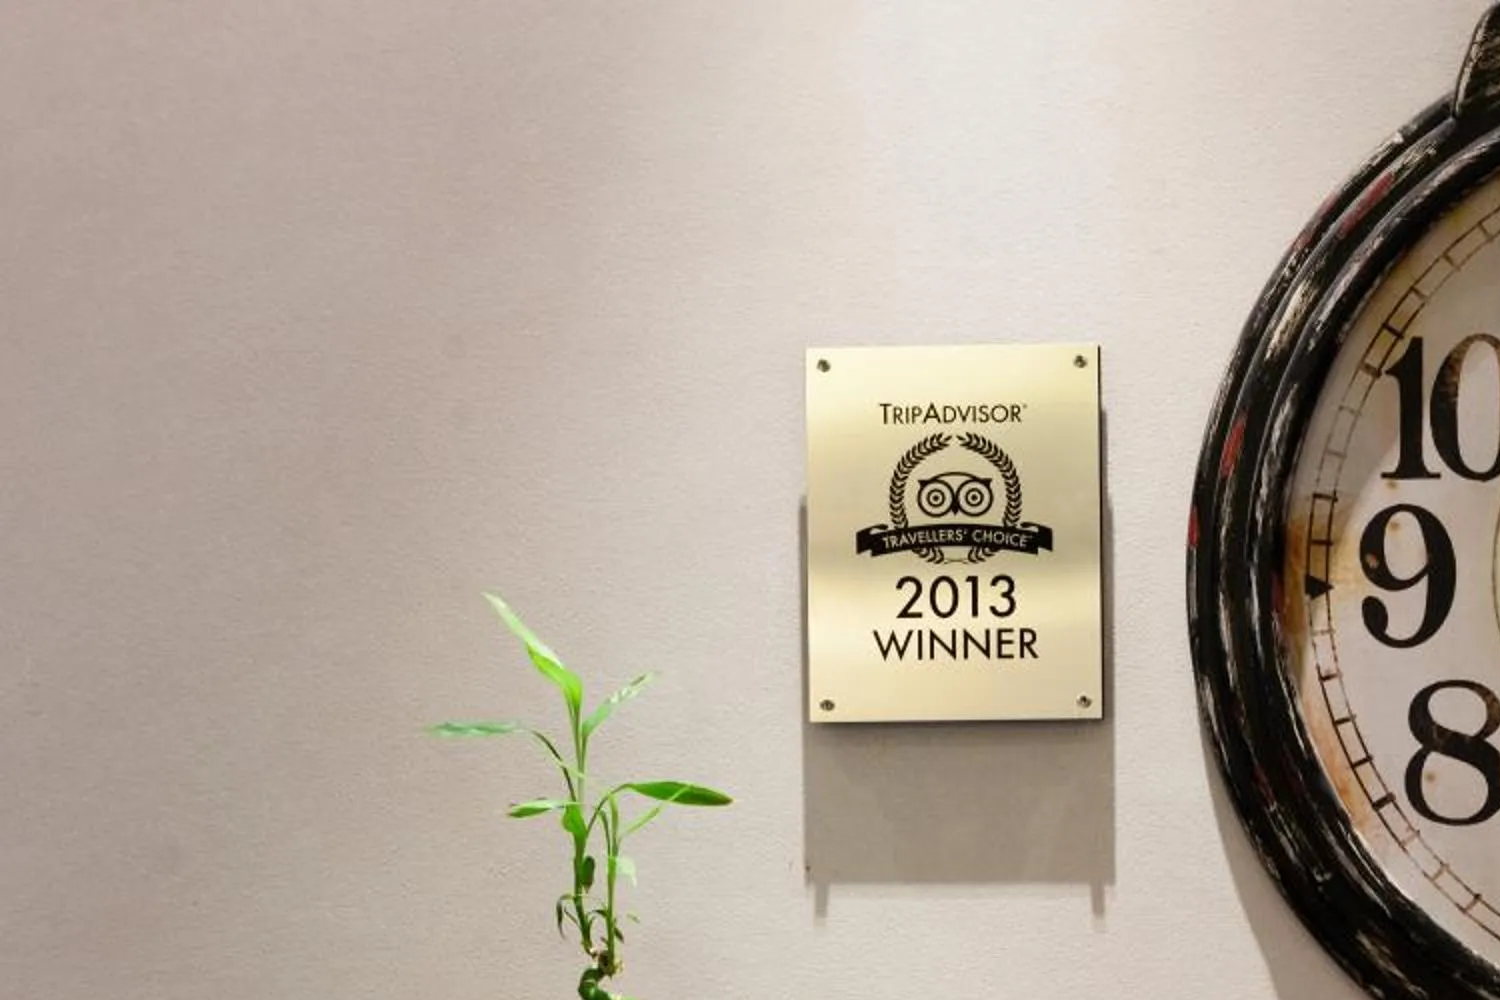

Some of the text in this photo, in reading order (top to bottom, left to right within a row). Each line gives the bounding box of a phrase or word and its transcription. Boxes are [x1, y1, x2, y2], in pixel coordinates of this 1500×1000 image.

[972, 530, 1029, 548] CHOICE
[896, 574, 1017, 619] 2013
[1360, 504, 1457, 649] 9
[873, 627, 1039, 662] WINNER
